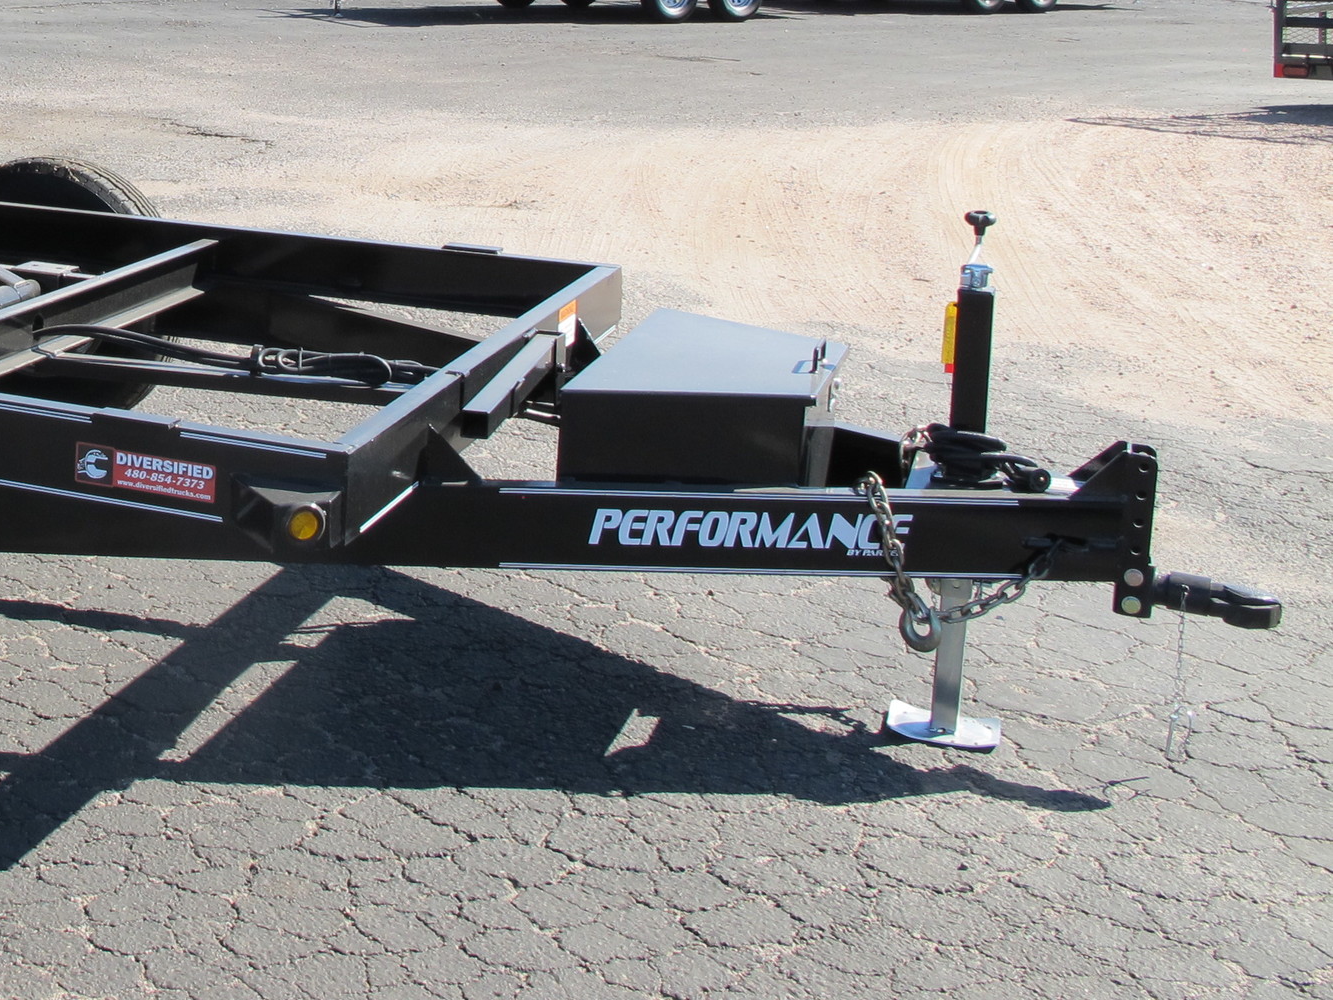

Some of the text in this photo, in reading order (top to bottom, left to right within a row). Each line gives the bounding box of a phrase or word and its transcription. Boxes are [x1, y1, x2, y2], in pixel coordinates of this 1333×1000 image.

[116, 451, 214, 480] DIVERSIFIED
[117, 479, 212, 501] www.diversifiedtrucks.com
[124, 468, 205, 490] 480-854-7373
[588, 508, 914, 550] PERFORMANCE
[846, 549, 862, 557] BY
